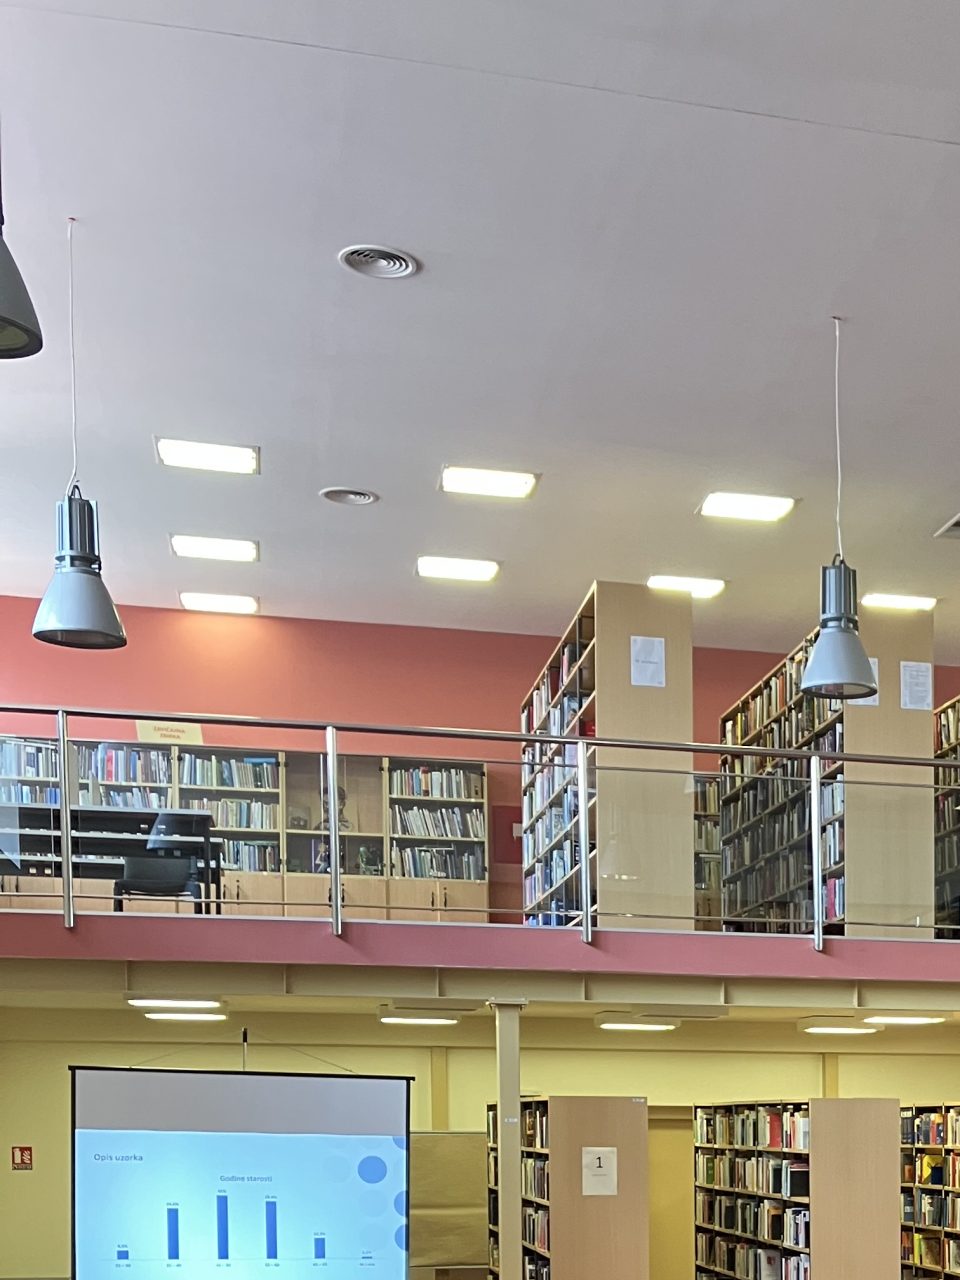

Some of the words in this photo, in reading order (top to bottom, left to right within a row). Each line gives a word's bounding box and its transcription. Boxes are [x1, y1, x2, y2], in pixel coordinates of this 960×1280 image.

[93, 1153, 113, 1162] Opis
[115, 1153, 144, 1161] uzorka
[595, 1156, 604, 1169] 1
